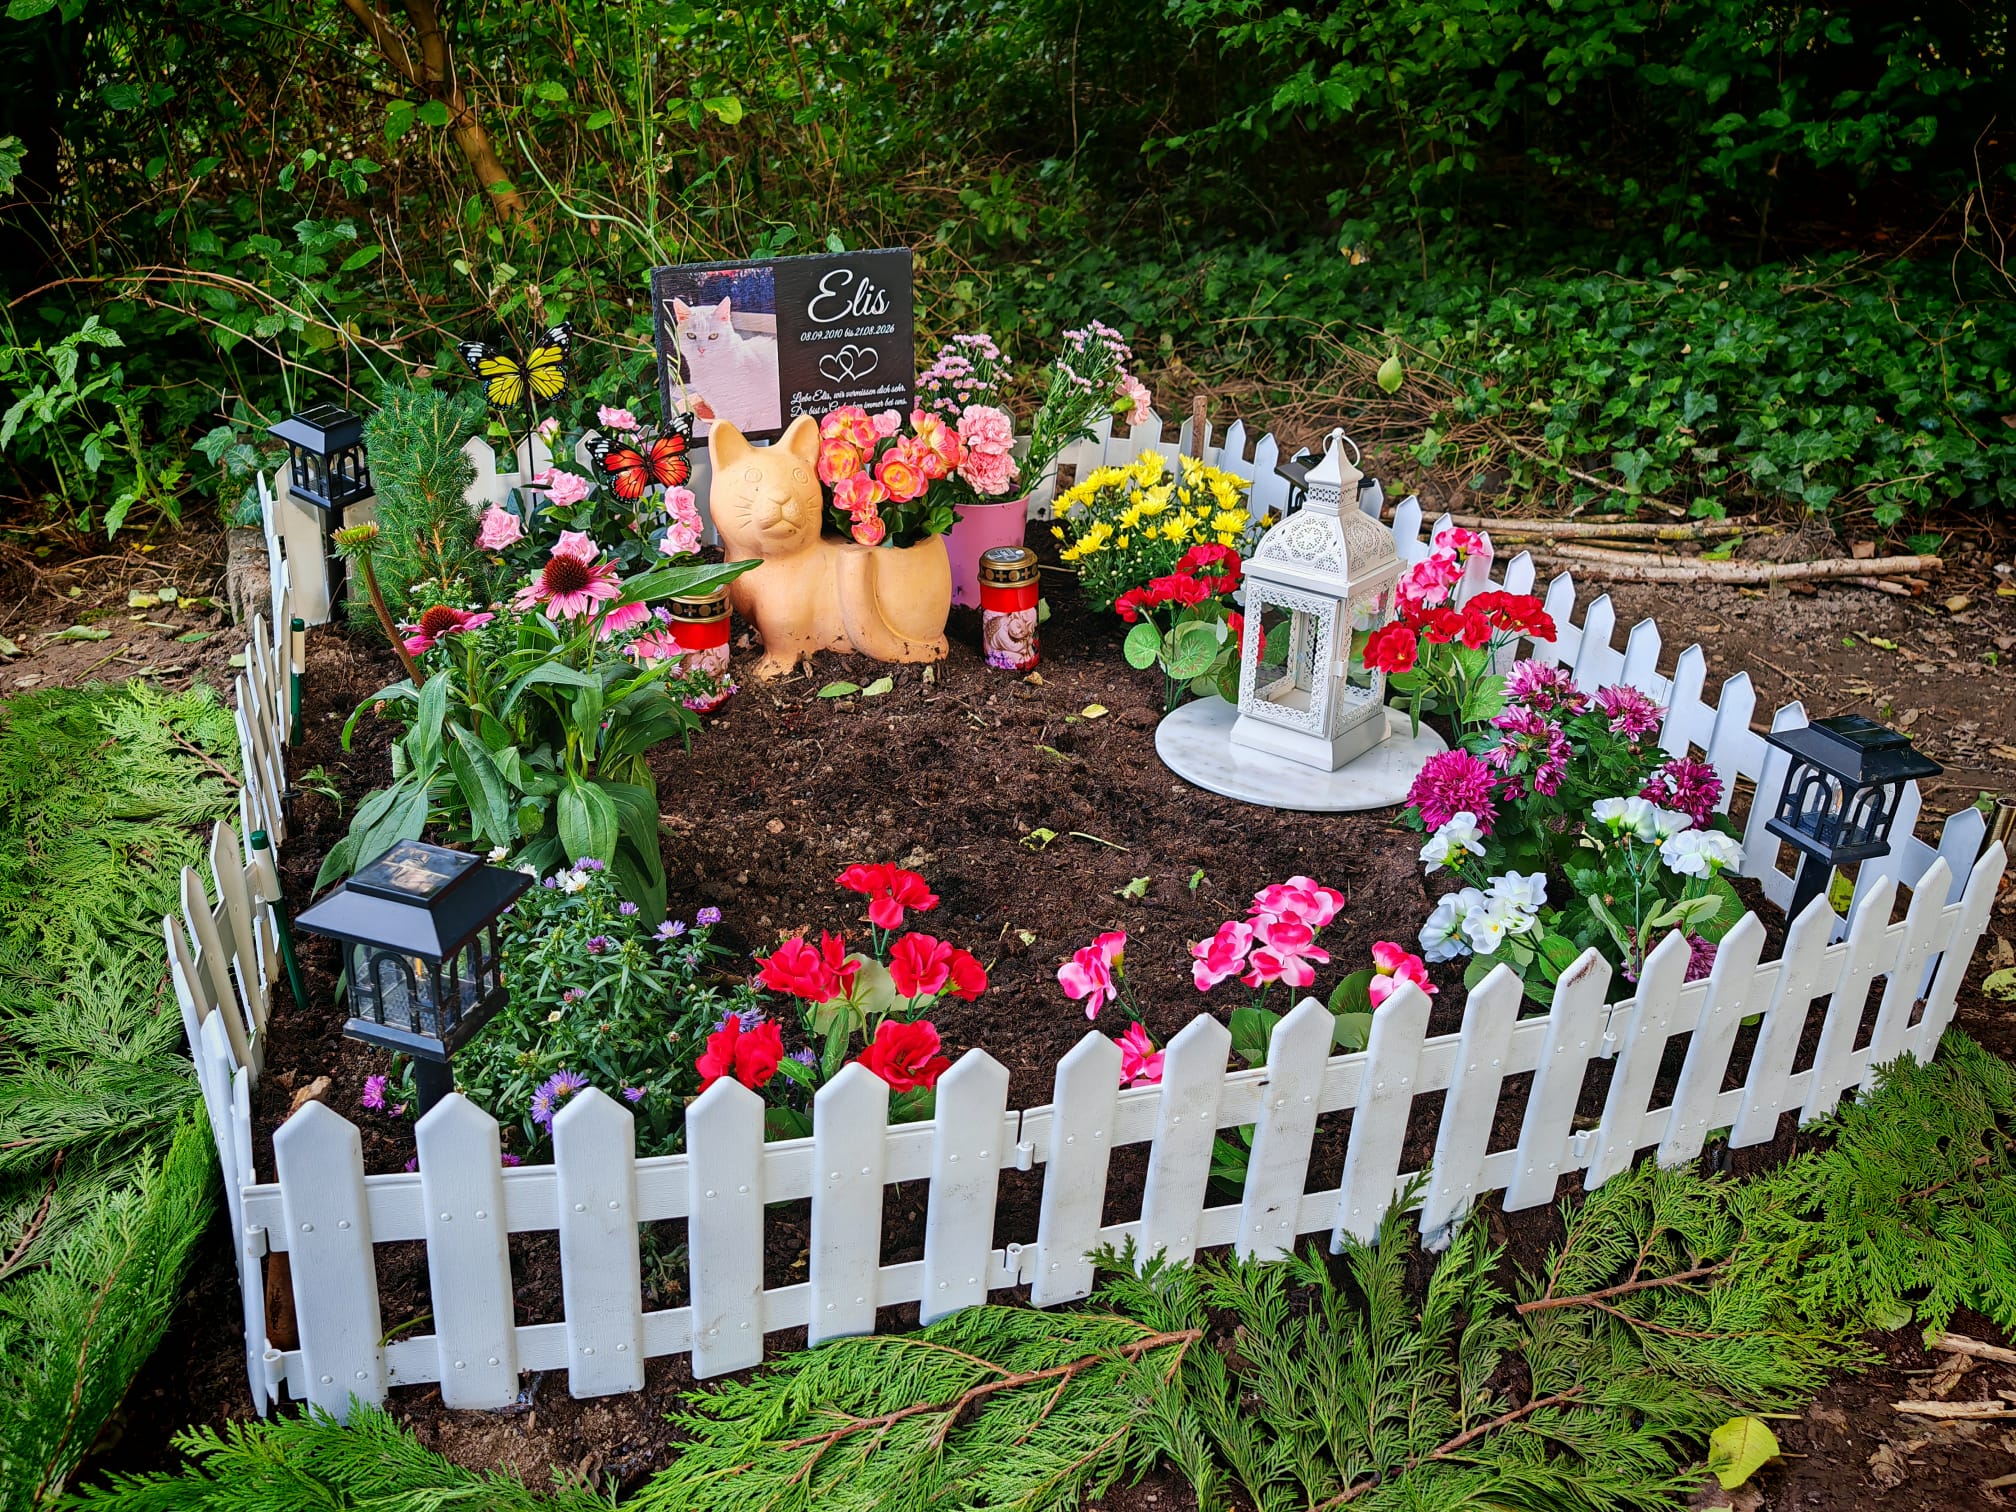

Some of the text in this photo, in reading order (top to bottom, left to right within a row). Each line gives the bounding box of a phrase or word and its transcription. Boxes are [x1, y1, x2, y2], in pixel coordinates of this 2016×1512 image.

[807, 268, 890, 323] Elis
[800, 323, 896, 342] 08.09.2010 bis 21.08.2026
[790, 391, 812, 405] Liebe
[812, 389, 832, 402] Elis,
[833, 390, 845, 399] wir
[845, 388, 876, 398] vermissen
[876, 384, 890, 394] dich
[809, 405, 821, 415] bist
[821, 406, 829, 414] in
[864, 401, 884, 409] immer
[884, 397, 895, 407] bei
